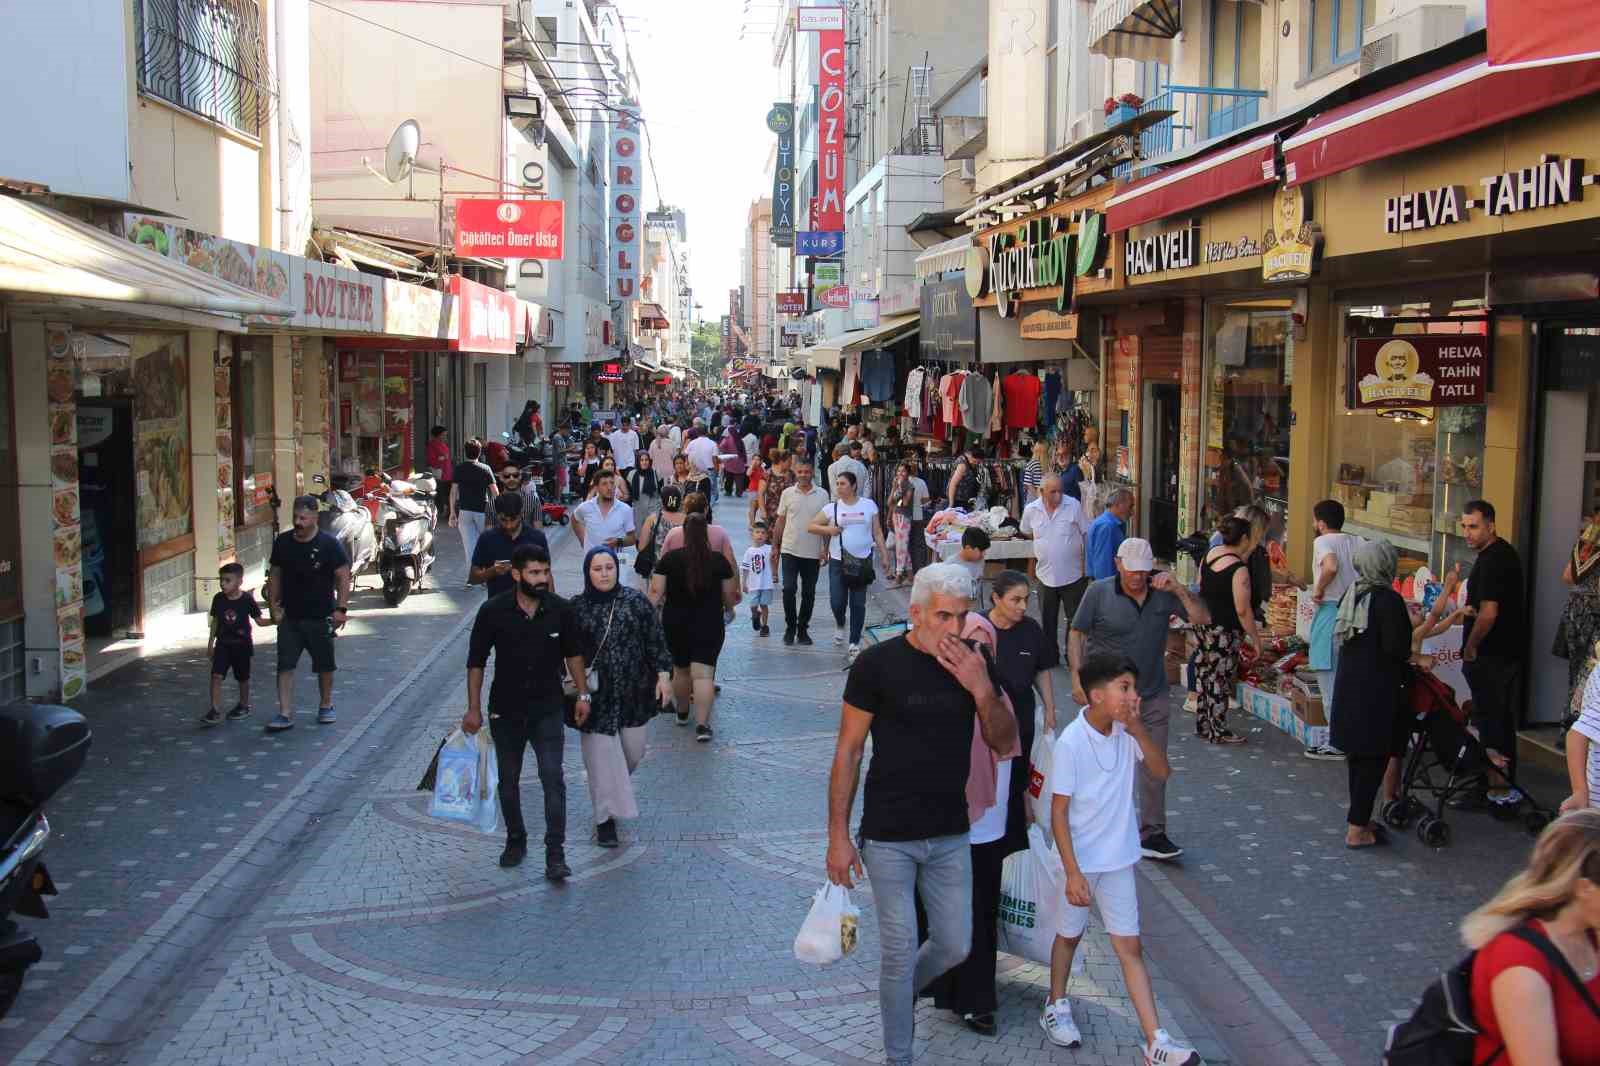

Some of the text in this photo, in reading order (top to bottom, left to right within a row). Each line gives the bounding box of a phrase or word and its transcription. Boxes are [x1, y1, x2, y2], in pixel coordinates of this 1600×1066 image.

[822, 48, 842, 213] ÇÖZÜM
[778, 136, 792, 227] UTOPYA
[1384, 185, 1460, 234] HELVA
[1480, 153, 1572, 216] TAHİN
[507, 227, 535, 247] Ömer
[535, 231, 558, 248] Usta
[802, 239, 838, 249] KURS
[1126, 221, 1193, 276] HACI VELİ
[304, 271, 374, 322] BOZTEPE
[1438, 347, 1482, 358] HELVA
[1439, 362, 1480, 378] TAHİN
[1439, 384, 1476, 396] TATLI
